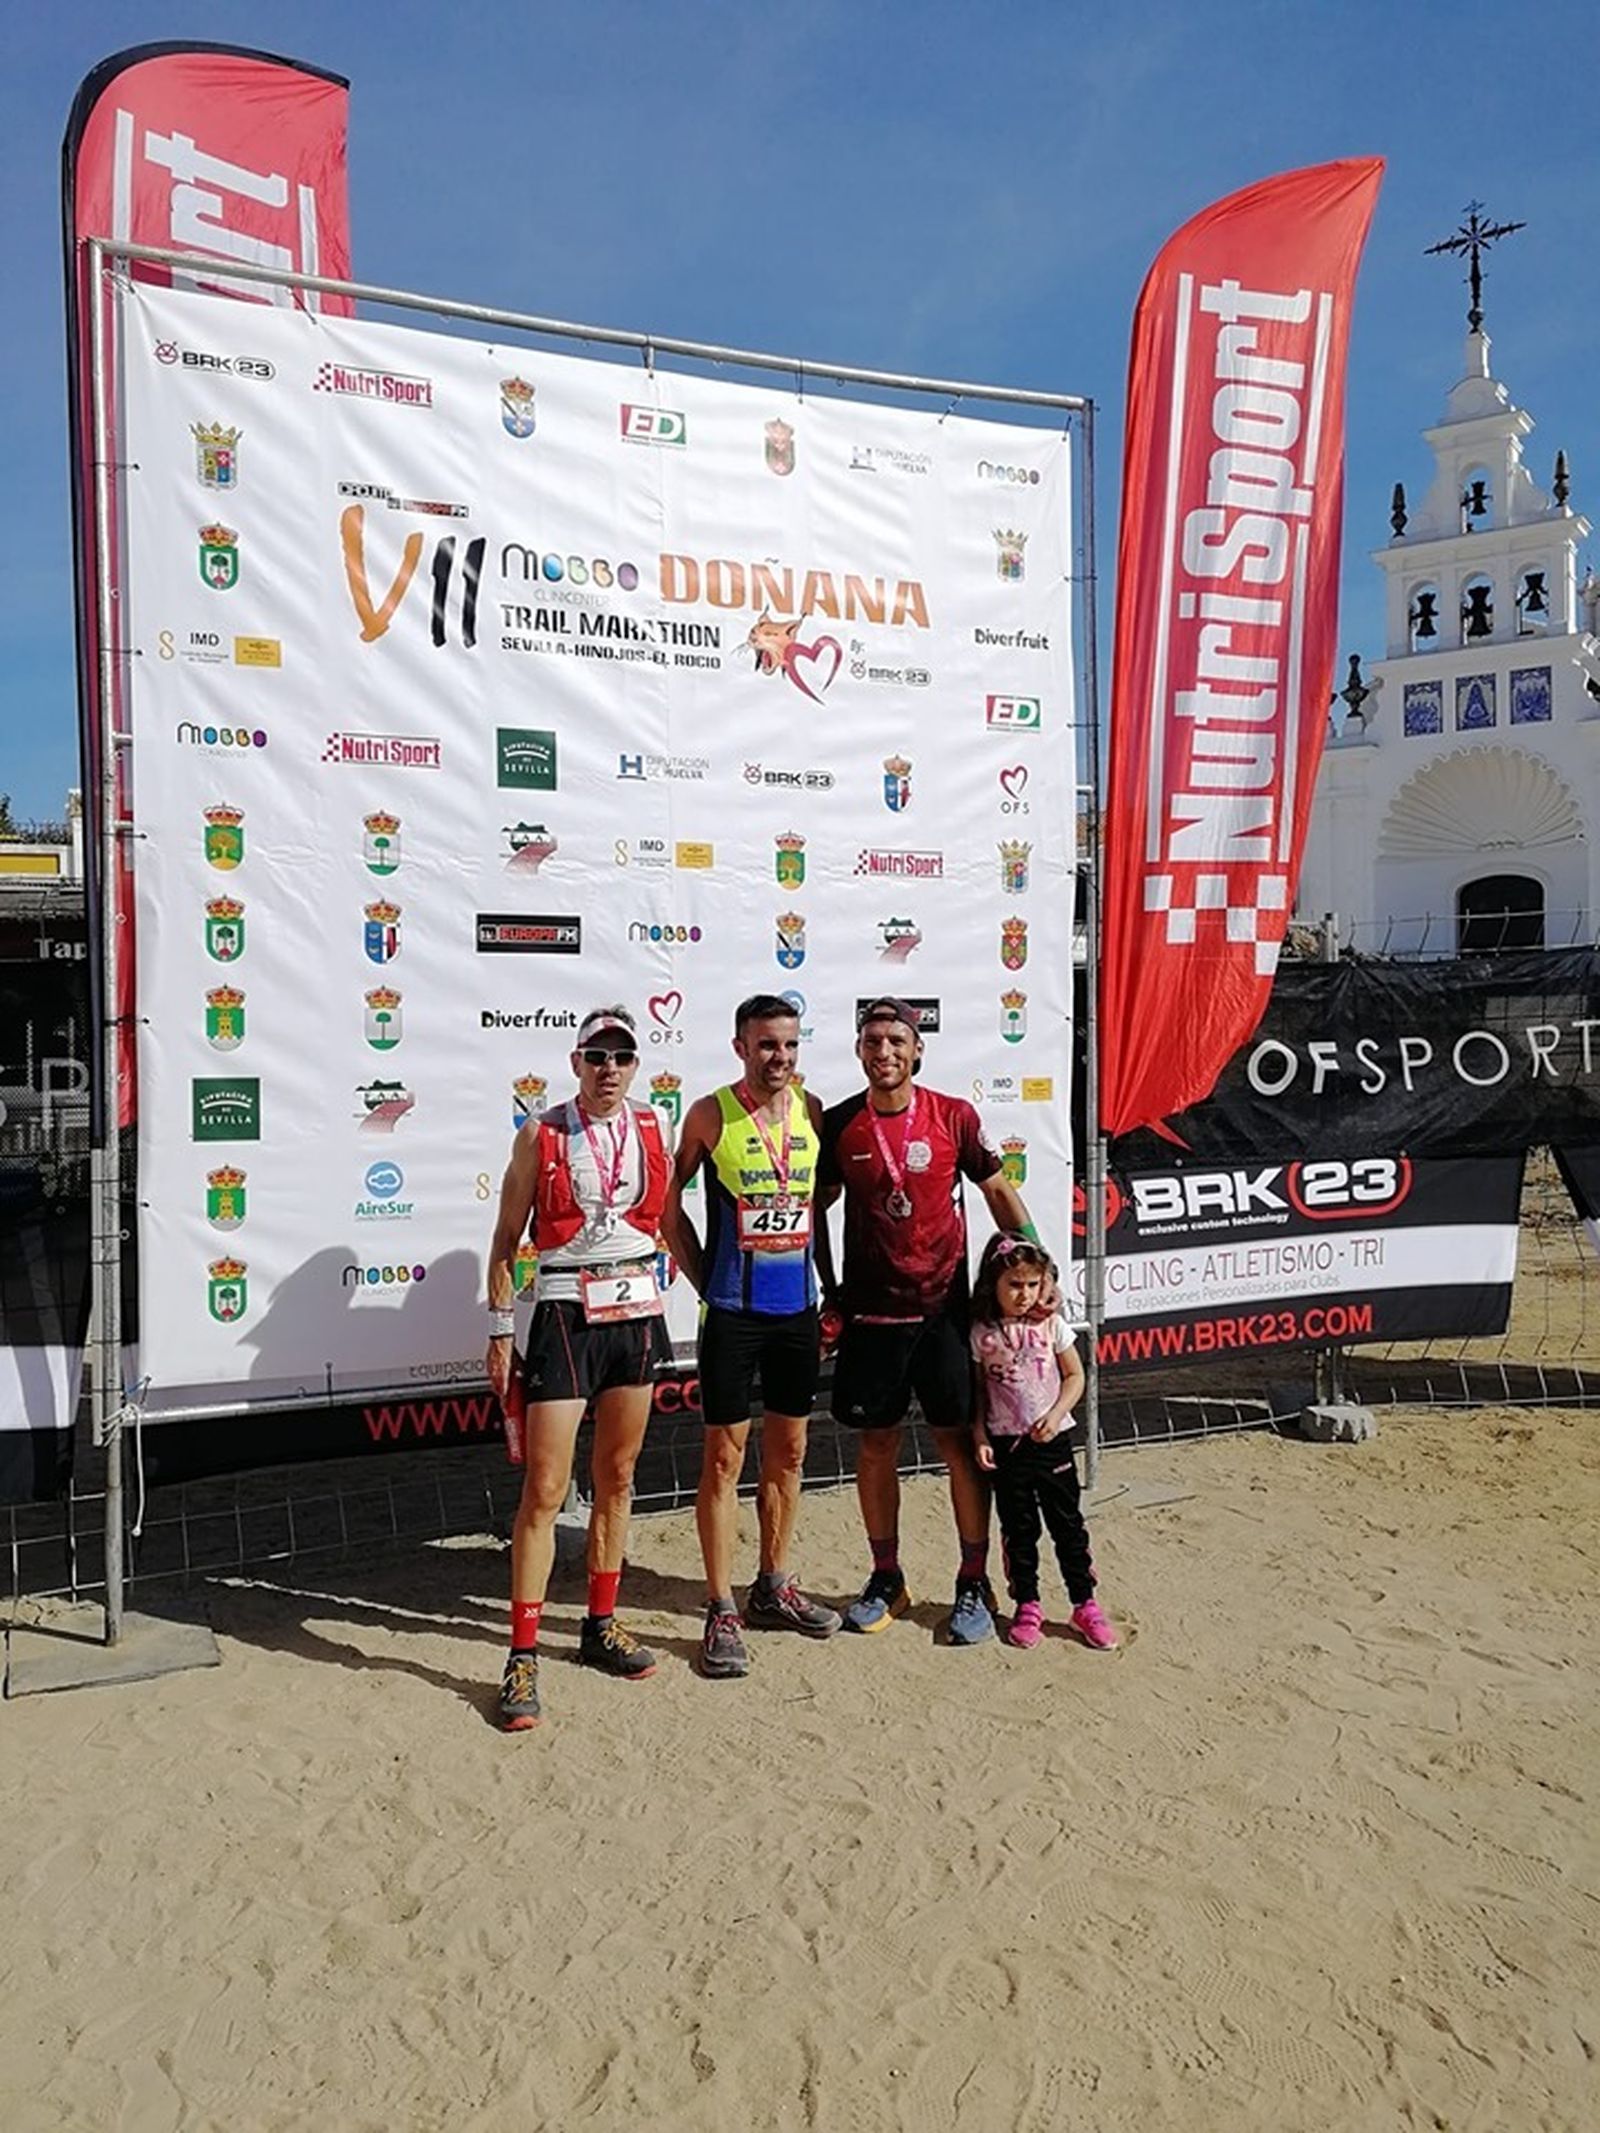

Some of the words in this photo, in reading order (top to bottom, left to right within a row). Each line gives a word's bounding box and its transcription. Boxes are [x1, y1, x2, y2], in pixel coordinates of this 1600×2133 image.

[182, 351, 231, 370] BRK
[238, 360, 270, 377] 23
[333, 367, 433, 403] NutriSport
[341, 503, 486, 648] VII
[1169, 279, 1314, 861] NutriSport
[659, 553, 931, 629] DOÑANA
[500, 604, 572, 634] TRAIL
[579, 612, 721, 649] MARATHON
[190, 632, 220, 647] IMD
[974, 627, 1050, 650] Diverfruit
[674, 654, 721, 669] ROCIO
[868, 667, 902, 682] BRK
[342, 736, 441, 767] NutriSport
[764, 771, 802, 786] BRK
[806, 774, 831, 788] 23
[1001, 801, 1030, 815] OFS
[640, 839, 665, 852] IMD
[868, 852, 944, 876] NutriSport
[481, 1007, 577, 1028] Diverfruit
[650, 1030, 684, 1044] OFS
[1248, 1019, 1600, 1097] OFSPORT
[201, 1115, 252, 1125] SEVILLA
[1132, 1166, 1289, 1222] BRK
[1302, 1159, 1398, 1207] 23
[355, 1200, 414, 1216] AireSur
[752, 1211, 804, 1232] 457
[1138, 1222, 1189, 1236] exclusive
[1191, 1218, 1230, 1230] custom
[1232, 1212, 1289, 1226] technology
[1202, 1241, 1333, 1283] ATLETISMO
[1350, 1238, 1385, 1268] TRI
[615, 1280, 632, 1302] 2
[1126, 1288, 1201, 1311] Equipaciones
[1203, 1282, 1280, 1301] Personalizadas
[1283, 1278, 1308, 1293] para
[1309, 1273, 1341, 1288] Clubs
[1096, 1303, 1373, 1365] WWW.BRK23.COM
[409, 1358, 486, 1379] Equipacio
